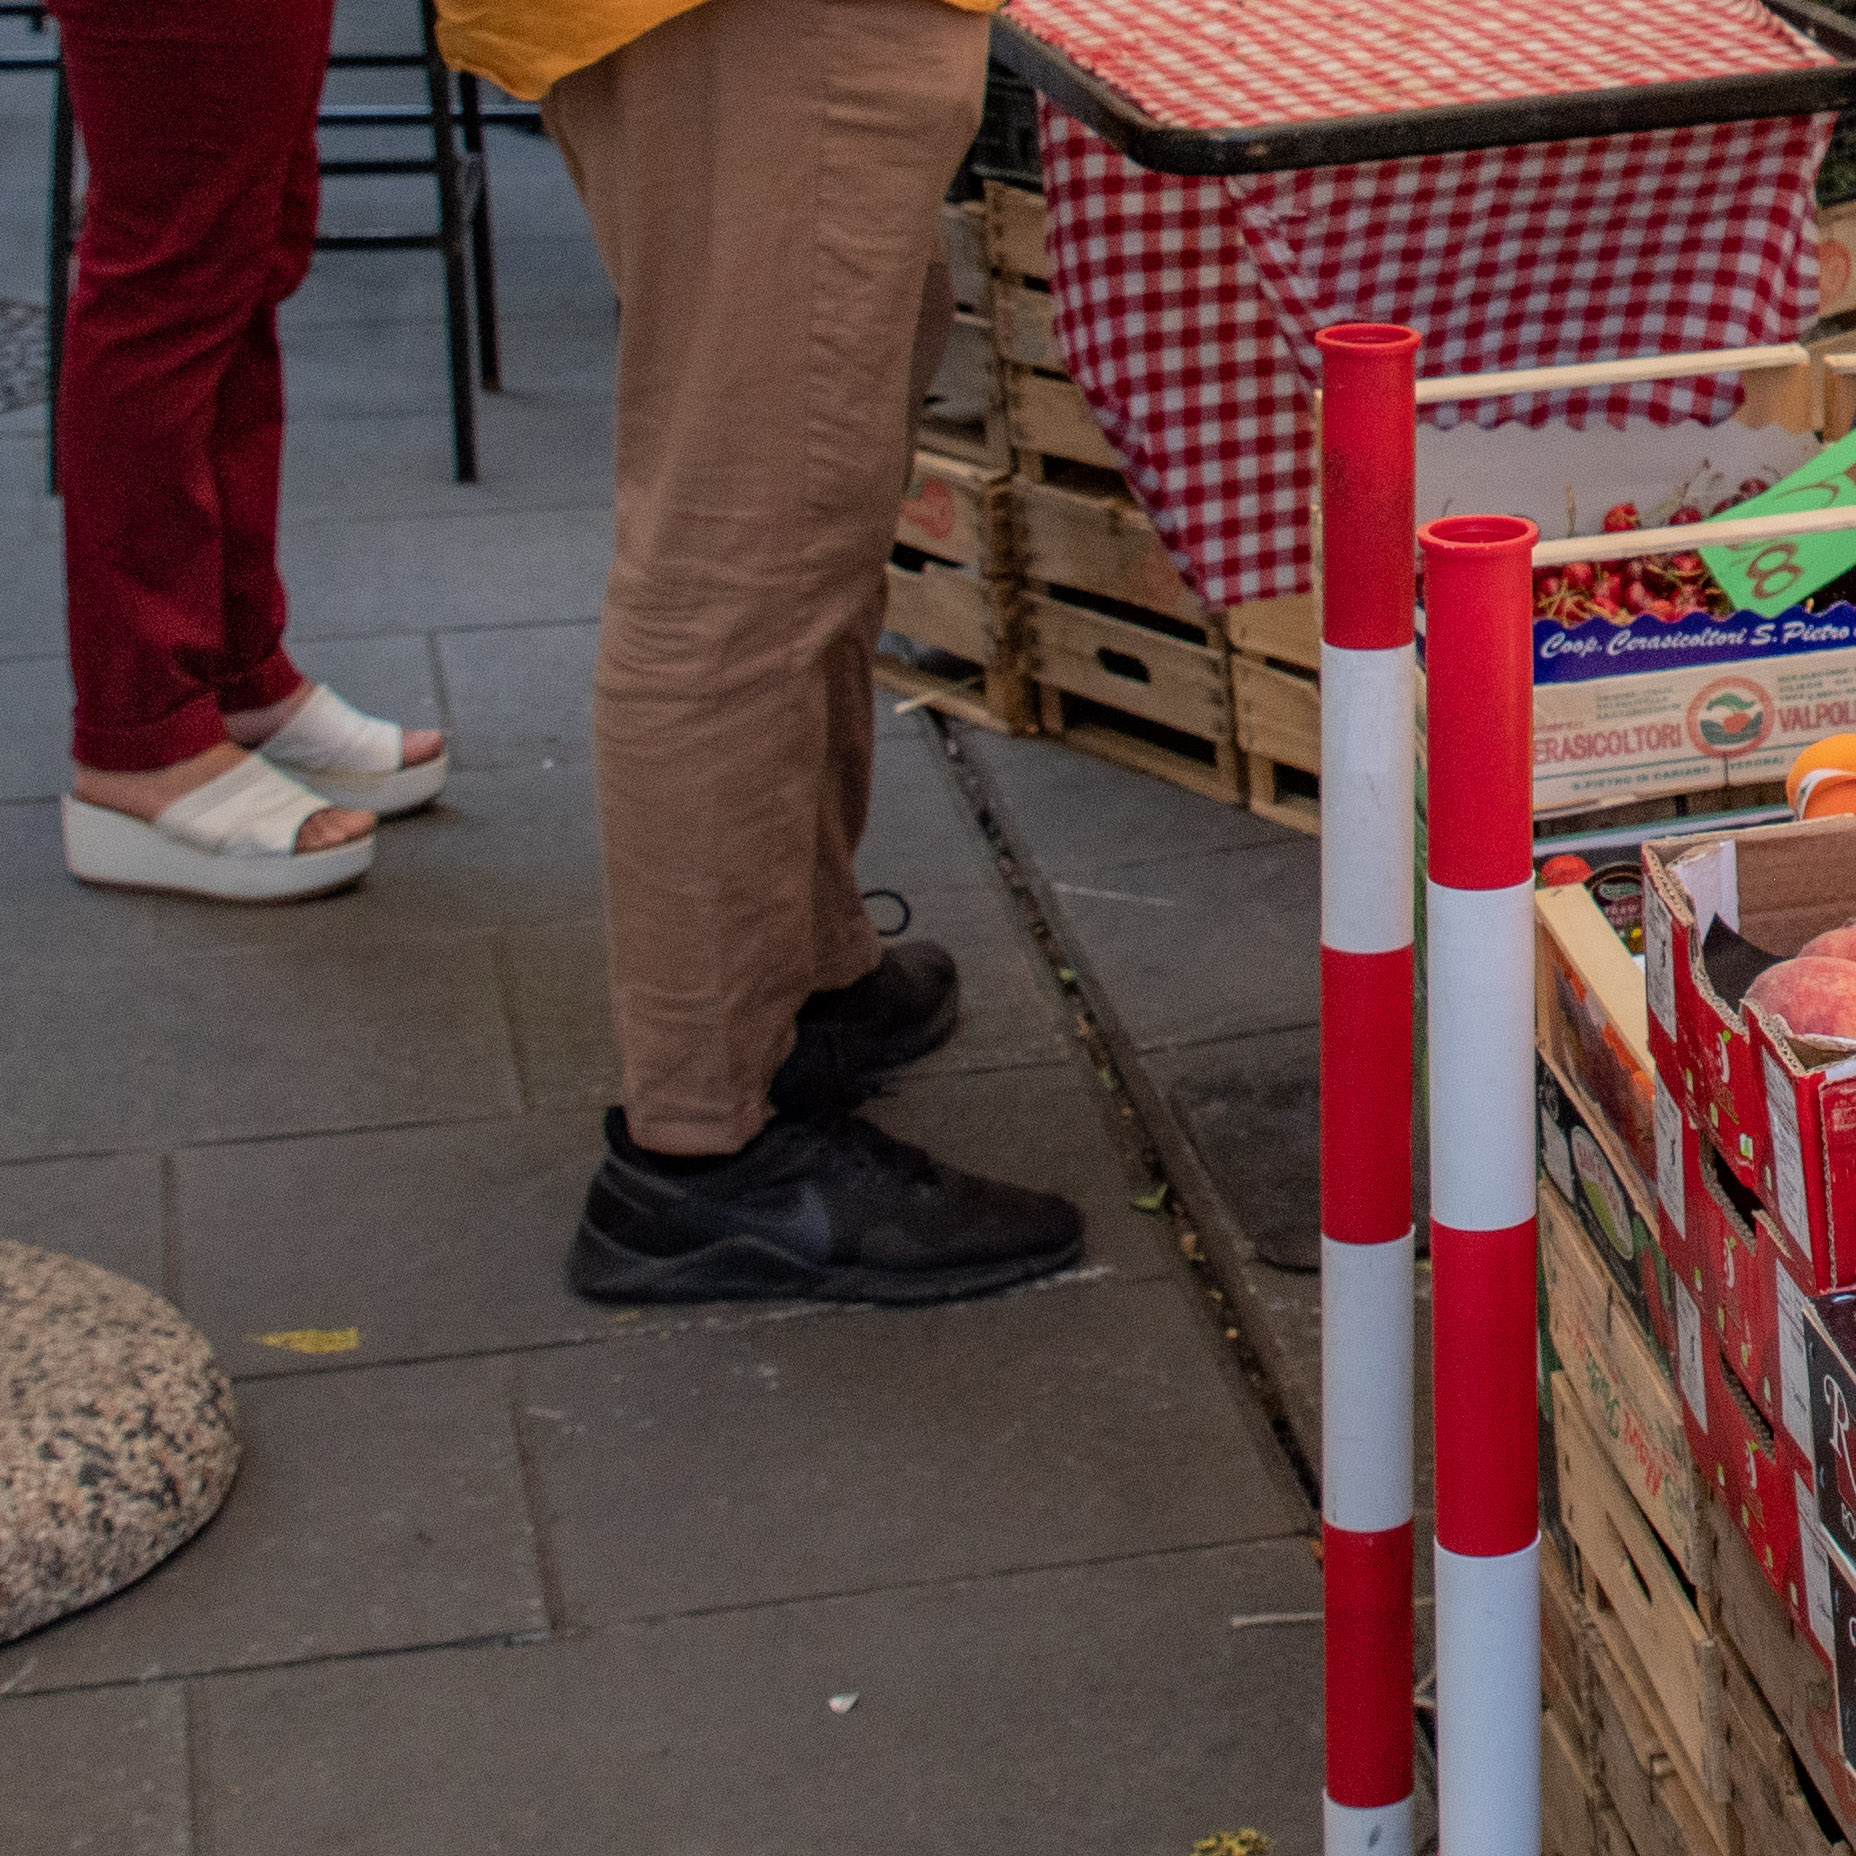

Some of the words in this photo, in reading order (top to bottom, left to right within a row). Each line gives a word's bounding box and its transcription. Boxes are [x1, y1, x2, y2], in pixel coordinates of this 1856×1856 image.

[1540, 630, 1603, 659] Coop.
[1606, 628, 1748, 656] Cerasicoltori
[1534, 723, 1681, 765] ERASICOLTORI
